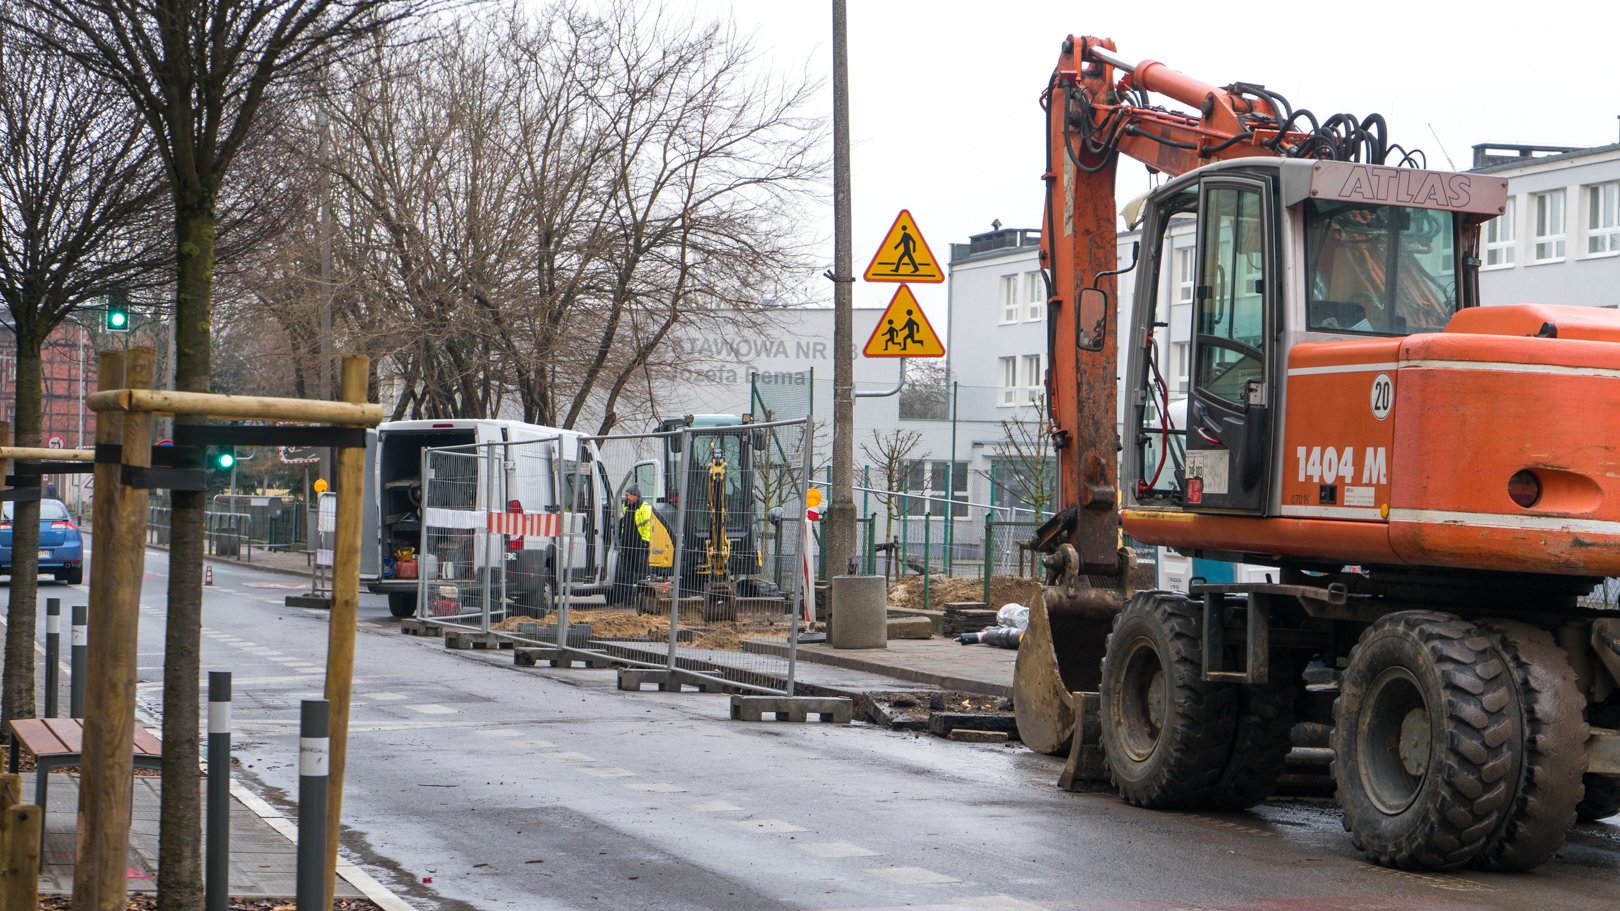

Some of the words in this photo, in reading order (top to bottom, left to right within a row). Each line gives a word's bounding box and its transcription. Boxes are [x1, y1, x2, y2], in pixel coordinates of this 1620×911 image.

[1338, 165, 1471, 207] ATLAS
[796, 341, 827, 360] NR
[1374, 381, 1390, 410] 20
[1296, 446, 1355, 484] 1404
[1362, 446, 1387, 485] M
